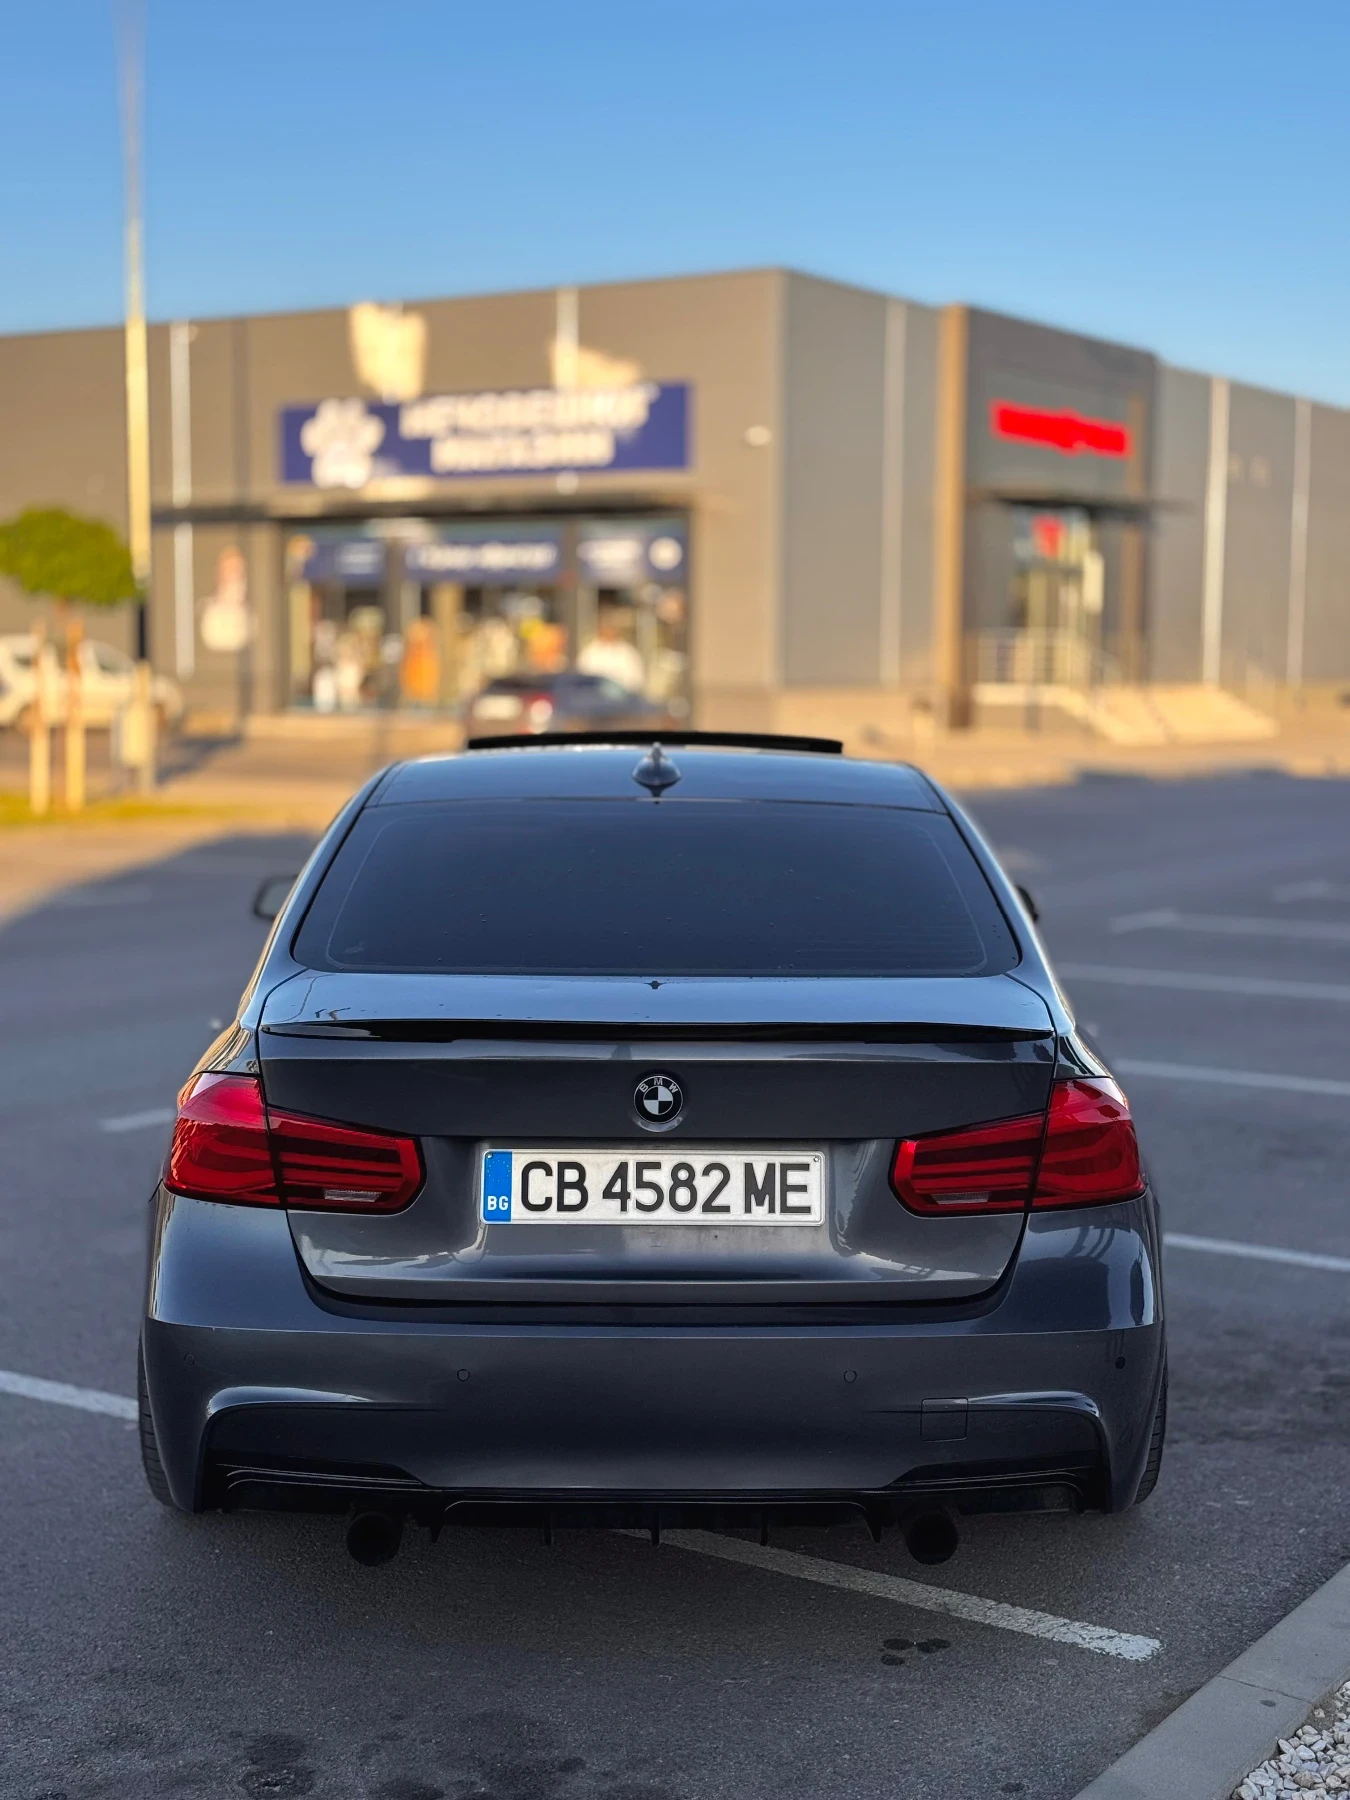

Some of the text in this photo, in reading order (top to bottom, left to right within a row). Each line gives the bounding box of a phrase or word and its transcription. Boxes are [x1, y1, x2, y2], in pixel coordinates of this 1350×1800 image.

[639, 1077, 679, 1093] BMW
[521, 1161, 812, 1214] CB 4582 ME
[487, 1196, 509, 1211] BG
